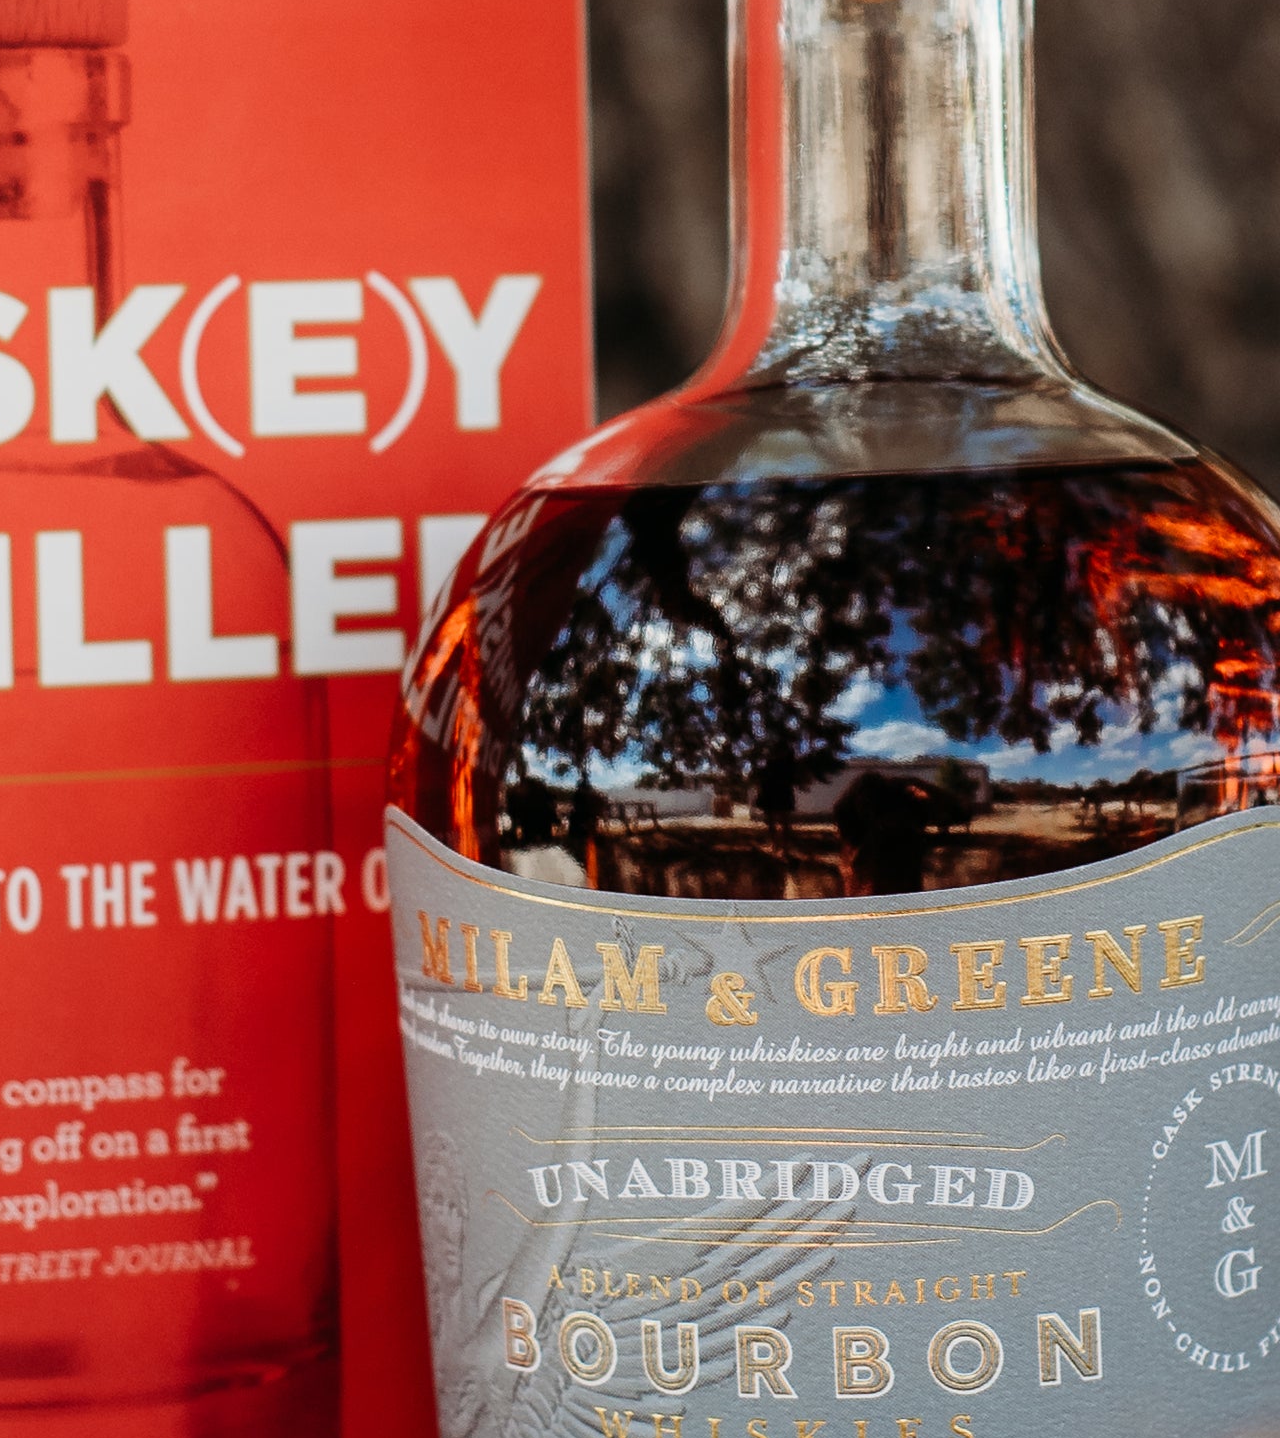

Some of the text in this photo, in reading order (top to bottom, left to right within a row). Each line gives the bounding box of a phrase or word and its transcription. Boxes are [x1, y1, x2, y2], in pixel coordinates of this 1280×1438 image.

[60, 861, 158, 930] THE
[174, 851, 347, 924] WATER
[417, 910, 1206, 1026] MILAM & GREENE
[438, 1003, 478, 1035] shares
[479, 1019, 499, 1040] its
[500, 1028, 539, 1048] own
[541, 1029, 596, 1063] story.
[596, 1027, 648, 1058] The
[650, 1038, 727, 1071] young
[729, 1035, 841, 1063] whiskies
[845, 1041, 888, 1063] are
[894, 1030, 972, 1067] bright
[975, 1027, 1026, 1056] and
[1030, 1022, 1117, 1051] vibrant
[1120, 1010, 1163, 1041] and
[1165, 1004, 1201, 1032] the
[1202, 995, 1237, 1026] old
[2, 1072, 165, 1112] compass
[172, 1056, 226, 1098] for
[453, 1034, 526, 1078] Together,
[530, 1053, 573, 1091] they
[574, 1065, 639, 1090] weave
[641, 1074, 662, 1091] a
[663, 1067, 762, 1102] complex
[769, 1070, 886, 1096] narrative
[890, 1064, 945, 1093] that
[946, 1066, 1022, 1091] tastes
[1026, 1054, 1072, 1084] like
[1077, 1064, 1098, 1079] a
[1099, 1037, 1215, 1084] first-class
[30, 1121, 86, 1164] off
[89, 1131, 140, 1160] on
[144, 1128, 170, 1156] a
[176, 1112, 252, 1155] first
[1152, 1087, 1204, 1160] CASK
[527, 1157, 1036, 1212] UNABRIDGED
[1204, 1129, 1269, 1190] M
[1222, 1196, 1256, 1234] &
[103, 1236, 256, 1276] JOURNAL
[546, 1263, 1029, 1307] A BLEND OF STRAIGHT
[1214, 1247, 1263, 1299] G
[1139, 1252, 1251, 1373] NON-CHILL
[501, 1297, 1104, 1400] BOURBON
